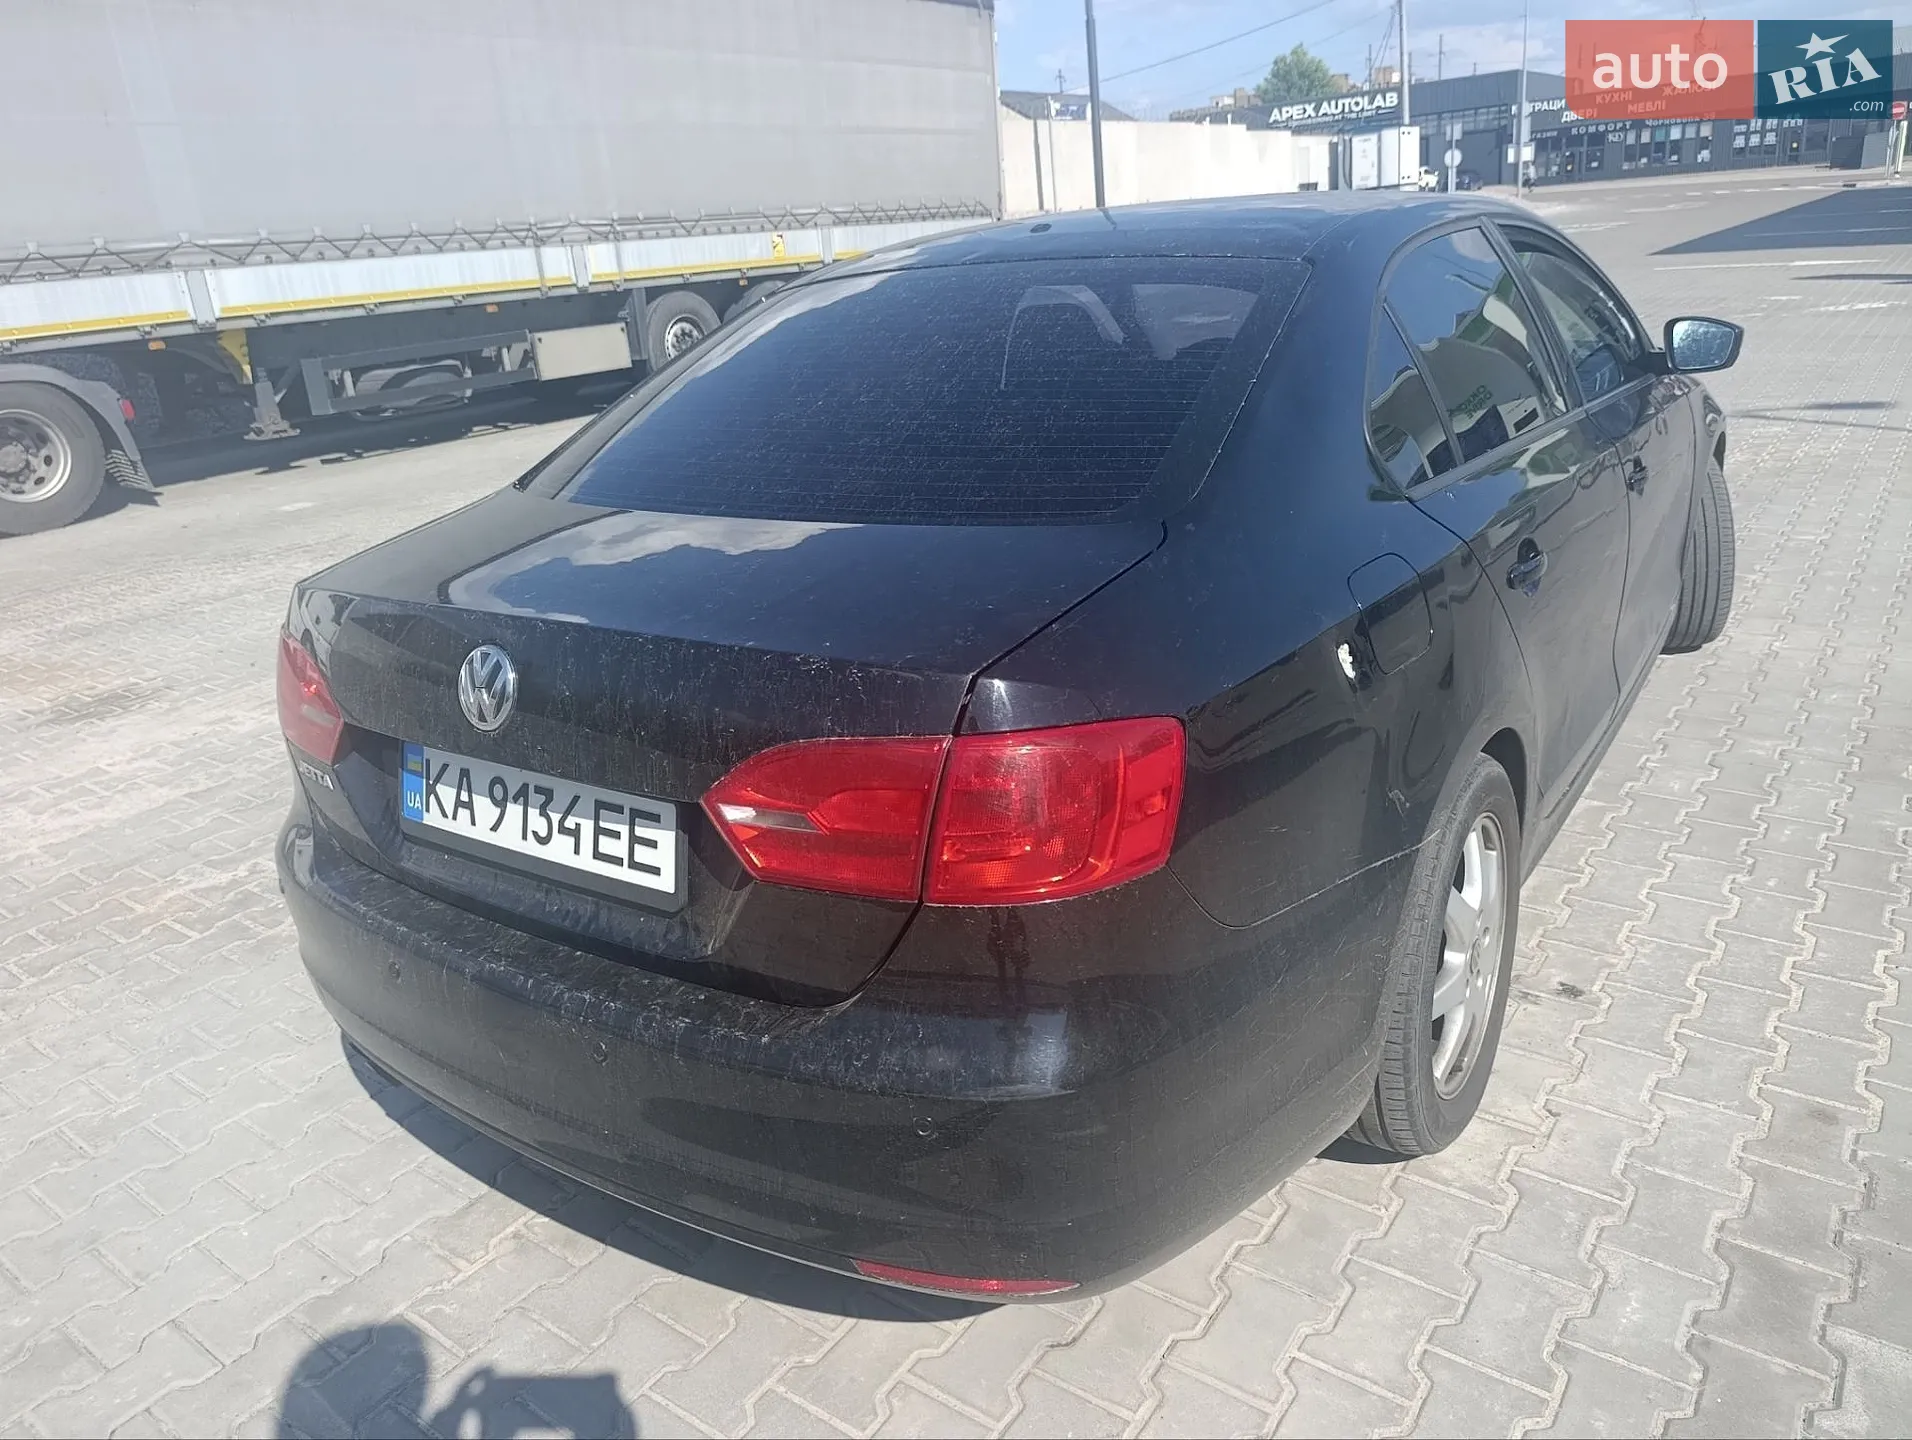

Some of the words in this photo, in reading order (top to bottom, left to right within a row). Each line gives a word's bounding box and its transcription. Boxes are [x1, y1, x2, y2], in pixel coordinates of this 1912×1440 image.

[1511, 98, 1566, 115] ТРАЦИ
[1595, 91, 1632, 105] КУХНІ
[1269, 103, 1316, 123] APEX
[1318, 92, 1398, 116] AUTOLAB
[1627, 100, 1666, 114] МЕБЛІ
[1571, 121, 1632, 135] КОМФОРТ
[407, 790, 422, 810] UA
[425, 758, 476, 827] KA
[488, 776, 581, 856] 9134
[593, 799, 661, 877] EE
